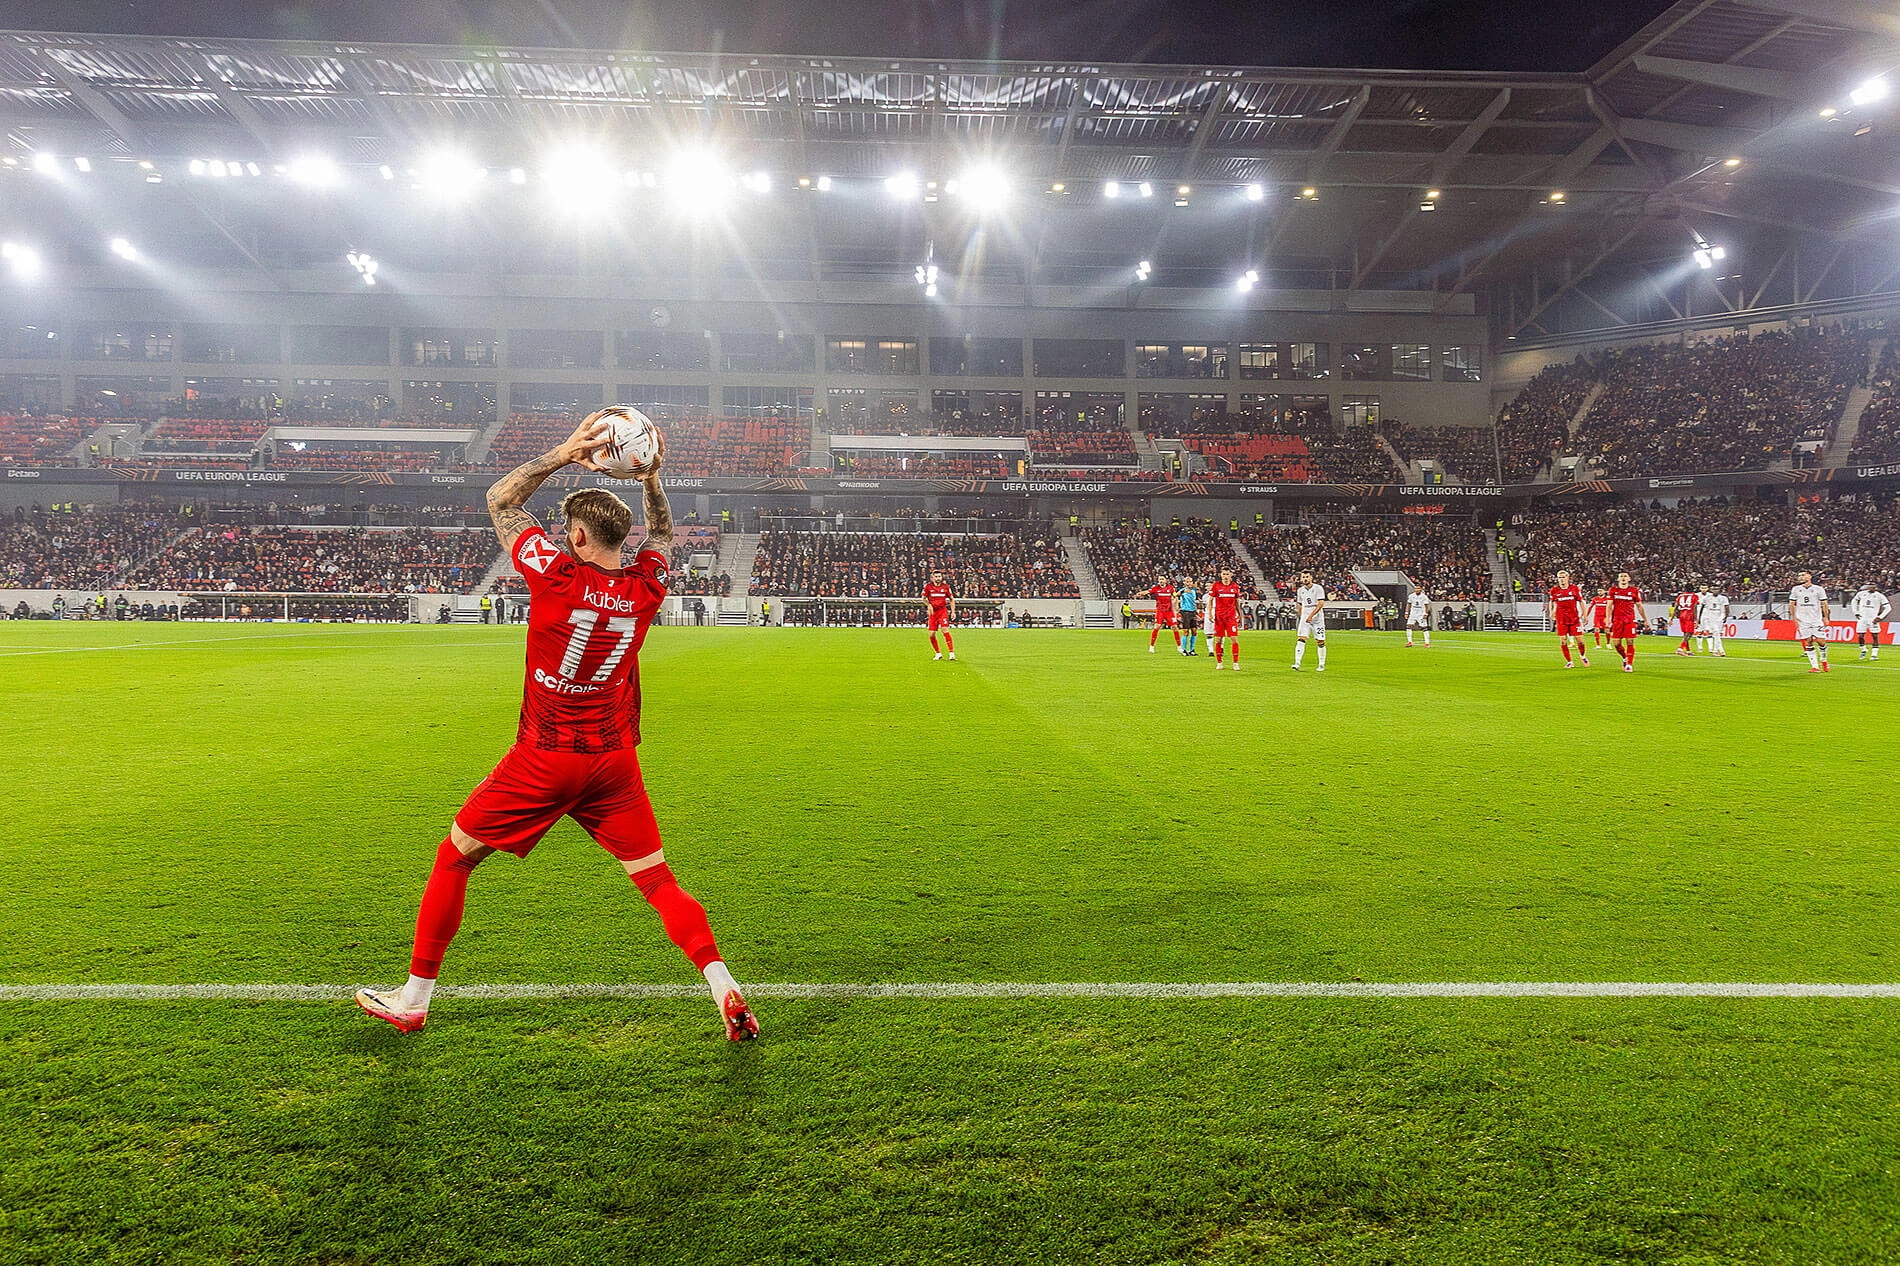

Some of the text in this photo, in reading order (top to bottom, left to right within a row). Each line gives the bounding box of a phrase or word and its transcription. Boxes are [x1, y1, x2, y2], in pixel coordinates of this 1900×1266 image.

[175, 471, 287, 481] UEFA EUROPA LEAGUE
[1857, 466, 1886, 478] UEFA
[596, 478, 623, 486] UEFA
[665, 478, 704, 487] LEAGUE
[1002, 482, 1107, 492] UEFA EUROPA LEAGUE
[1399, 487, 1503, 496] UEFA EUROPA LEAGUE
[583, 585, 635, 613] kübler
[558, 608, 639, 682] 17
